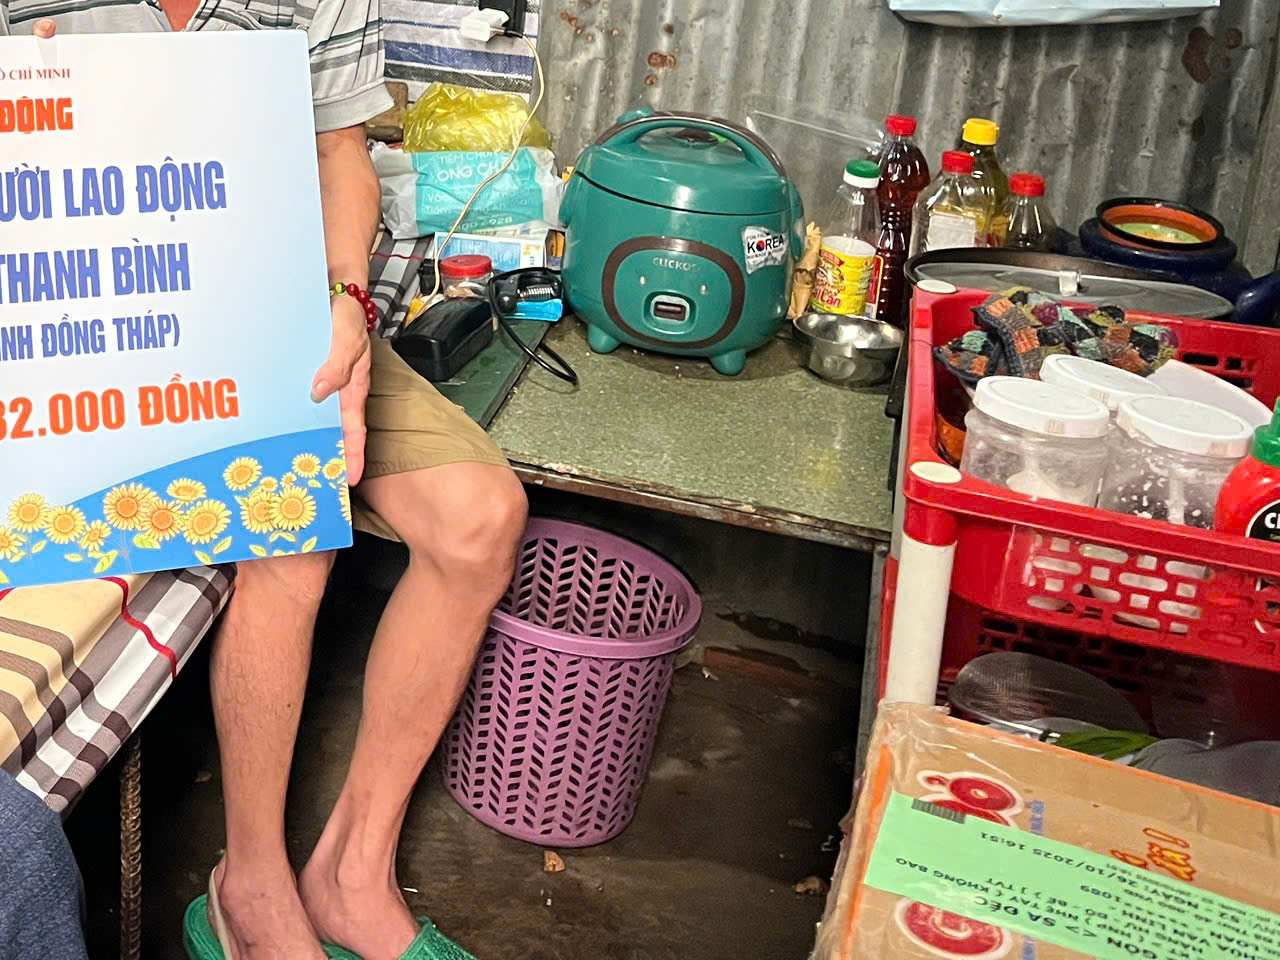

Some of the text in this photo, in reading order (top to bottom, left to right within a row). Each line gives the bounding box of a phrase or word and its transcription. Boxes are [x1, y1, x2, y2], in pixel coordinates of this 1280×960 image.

[36, 68, 71, 80] MINH
[63, 165, 125, 218] LAO
[135, 155, 227, 222] ĐỘNG
[747, 234, 785, 254] KOREA
[111, 237, 191, 296] BÌNH
[41, 313, 106, 358] ĐỒNG
[112, 309, 180, 351] THÁP)
[138, 373, 240, 427] ĐỒNG
[980, 831, 1025, 851] 16:51
[895, 857, 928, 873] BAO
[1032, 848, 1138, 888] 26/10/2025
[933, 870, 989, 893] KHÔNG
[985, 877, 1014, 891] TVT
[973, 895, 1019, 916] ĐÉC
[1009, 895, 1041, 910] TAY
[1027, 911, 1056, 927] SA
